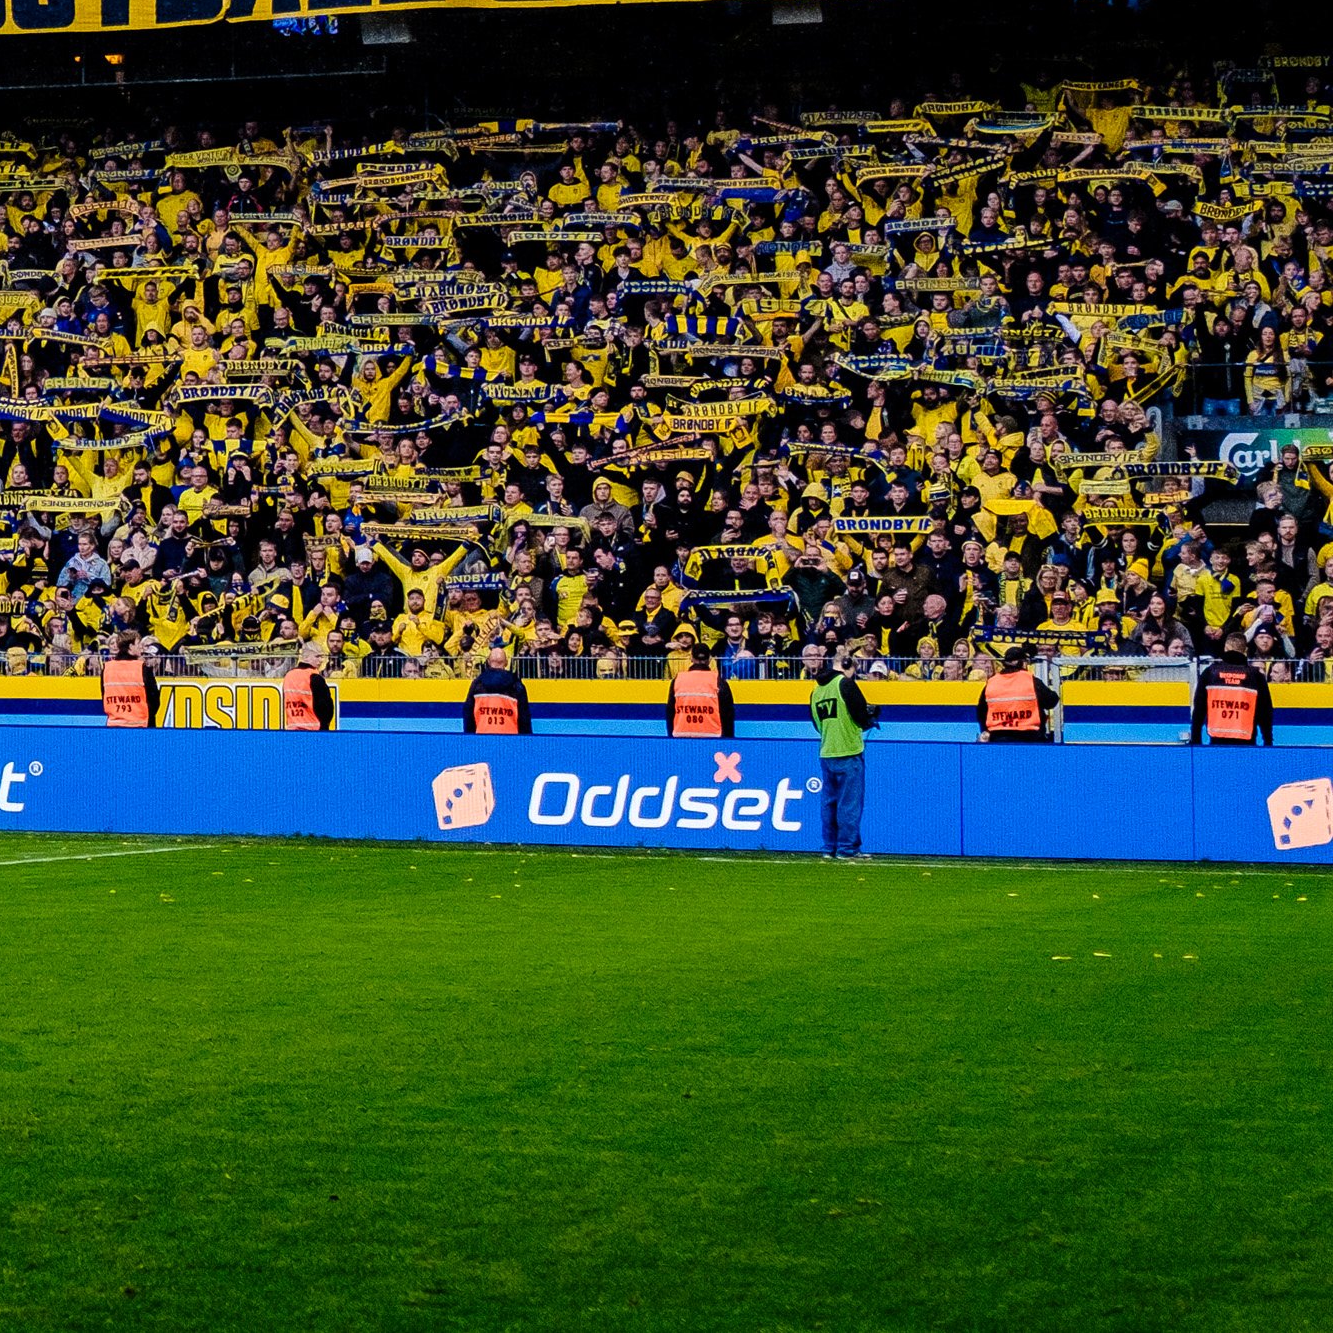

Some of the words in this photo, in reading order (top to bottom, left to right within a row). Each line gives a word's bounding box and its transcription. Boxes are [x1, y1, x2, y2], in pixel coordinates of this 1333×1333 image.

[1068, 303, 1125, 313] BRØNDBY
[183, 387, 246, 398] BRØNDBY
[673, 418, 723, 430] BRØNDBY
[836, 518, 911, 532] BRØNDBY
[107, 696, 141, 705] STEWARD
[1212, 700, 1249, 710] STEWARD
[116, 705, 132, 714] 793
[480, 707, 513, 716] STEWARD
[677, 706, 714, 715] STEWARD
[992, 710, 1032, 720] STEWARD
[1222, 711, 1240, 719] 071
[488, 717, 505, 725] 013
[528, 773, 804, 831] Oddset
